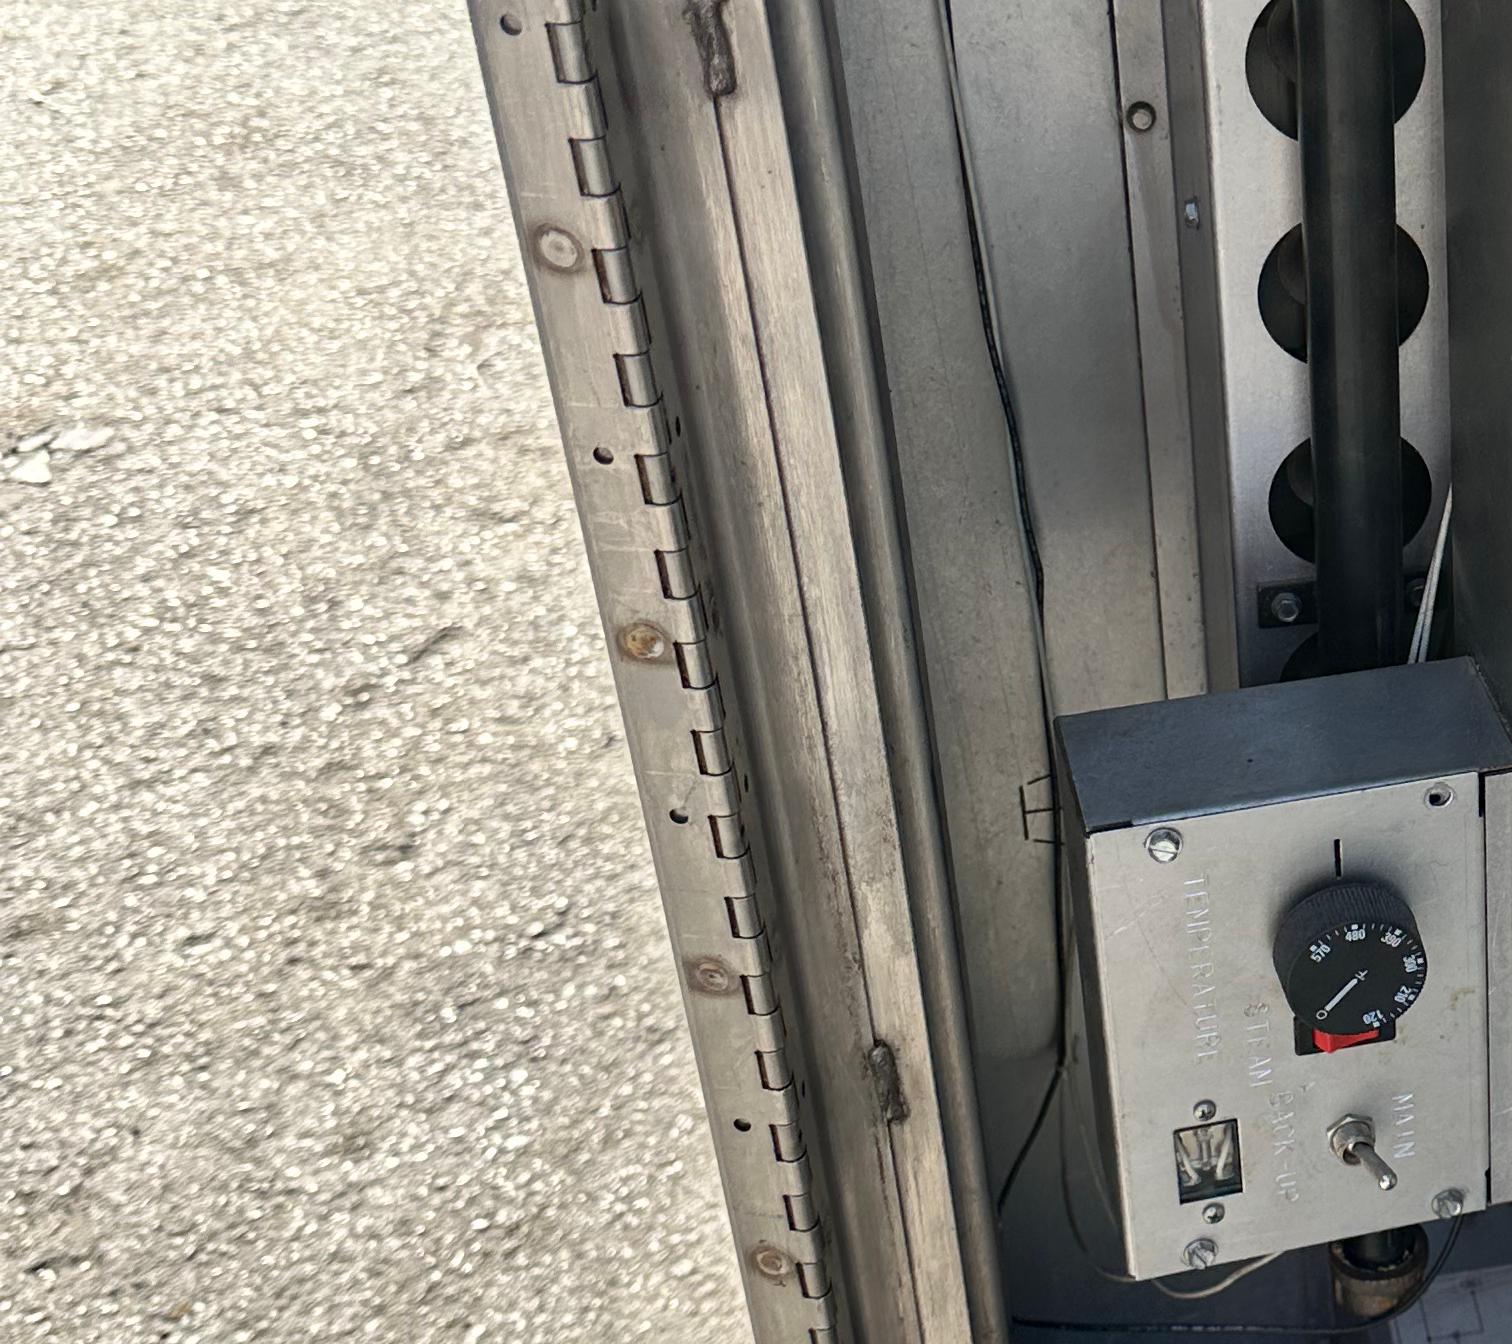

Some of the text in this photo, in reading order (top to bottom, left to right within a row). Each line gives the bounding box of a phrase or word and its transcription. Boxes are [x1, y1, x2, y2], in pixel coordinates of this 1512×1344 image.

[1345, 929, 1366, 941] 480
[1381, 932, 1401, 947] 390
[1310, 944, 1331, 962] 570
[1184, 874, 1222, 1057] TEMPERATURE
[1394, 986, 1411, 1003] 210
[1363, 1010, 1383, 1024] 120
[1244, 1003, 1298, 1204] STEAM BACK-UP
[1392, 1094, 1415, 1158] MAIN
